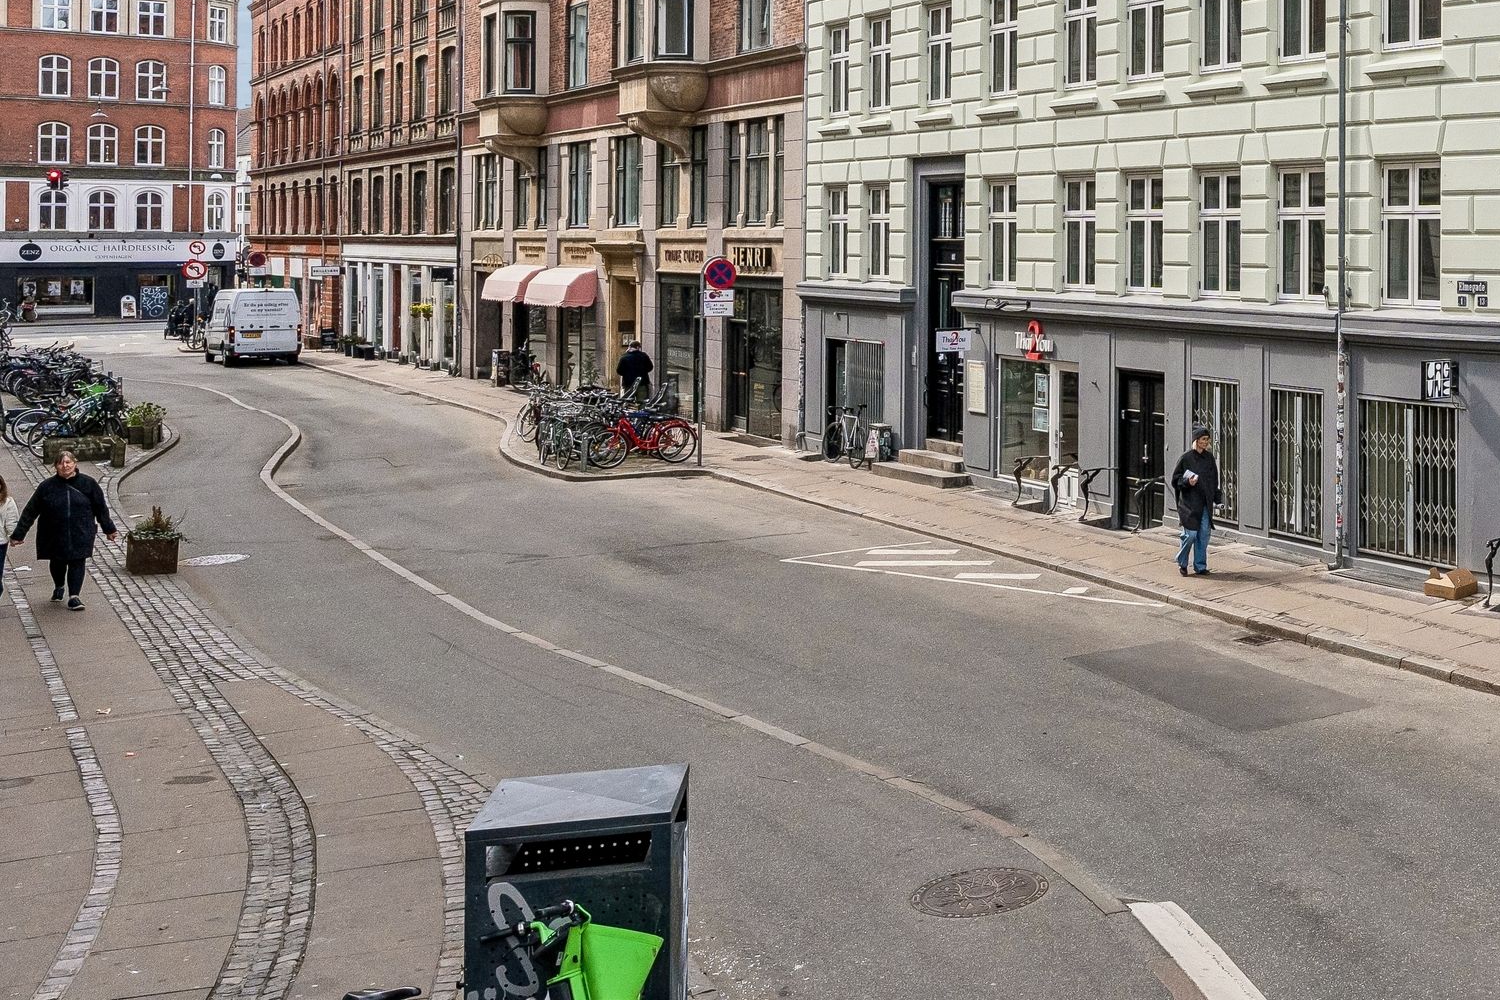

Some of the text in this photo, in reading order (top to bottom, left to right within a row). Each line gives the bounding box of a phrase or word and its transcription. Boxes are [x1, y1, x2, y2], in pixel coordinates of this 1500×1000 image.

[732, 247, 766, 267] HENRI
[1458, 282, 1485, 293] Elmegade
[950, 331, 959, 346] 2
[1025, 320, 1043, 360] 2
